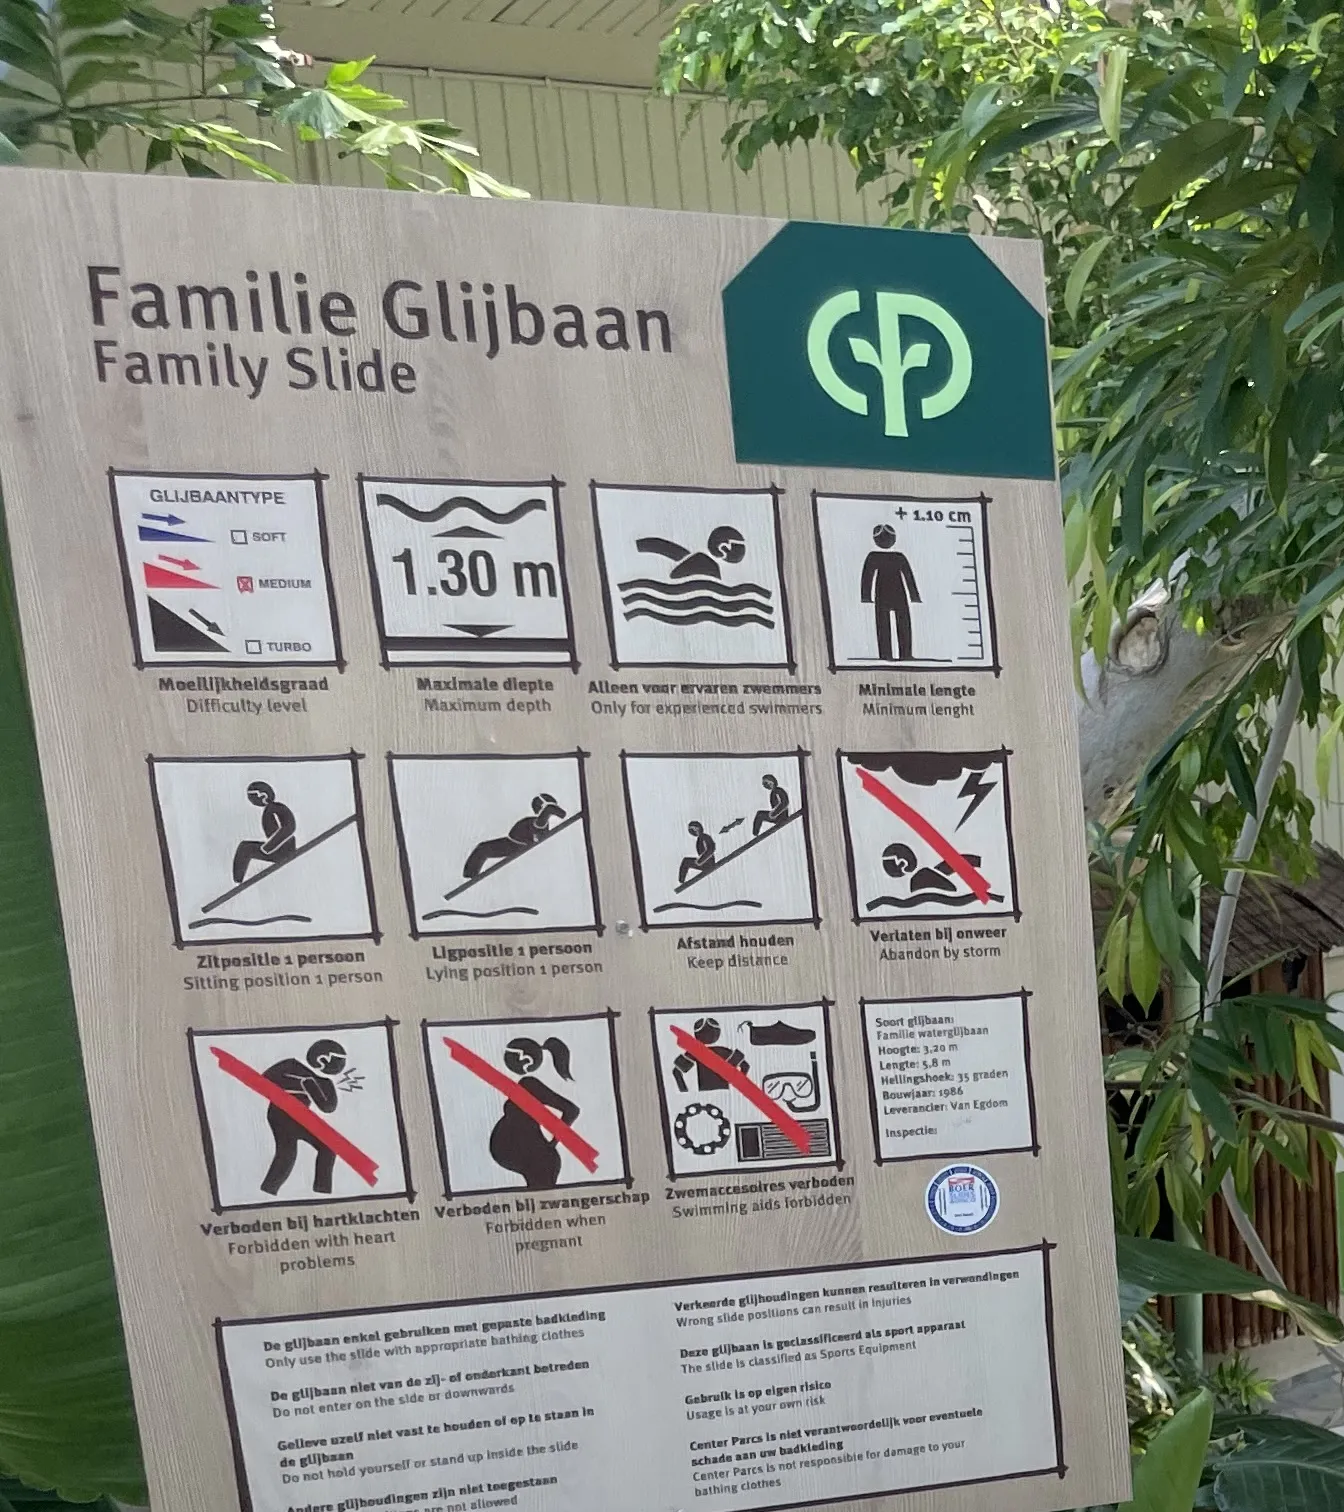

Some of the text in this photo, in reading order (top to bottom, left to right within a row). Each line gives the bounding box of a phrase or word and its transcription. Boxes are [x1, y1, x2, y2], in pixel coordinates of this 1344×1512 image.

[87, 265, 672, 359] Familie Glijbaan
[93, 340, 416, 400] Family Slide
[150, 489, 287, 505] GLIJBAANTYPE
[913, 510, 944, 523] 1.10
[948, 510, 972, 523] cm
[252, 531, 286, 543] SOFT
[392, 548, 558, 598] 1.30 m
[258, 577, 312, 590] MEDIUM
[266, 641, 312, 653] TURBO
[159, 676, 329, 695] Moeilijkheidsgraad
[417, 677, 554, 696] Maximale diepte
[588, 681, 822, 696] Alleen voor ervaren zwemmers
[858, 683, 976, 702] Minimale lengte
[186, 697, 308, 715] Difficulty level
[424, 698, 551, 717] Maximum depth
[591, 701, 823, 718] Only for experienced swimmers
[862, 702, 975, 719] Minimum lenght
[677, 934, 794, 950] Afstand houden
[870, 926, 1007, 946] Verlaten bij onweer
[197, 951, 365, 972] Zitpositie 1 persoon
[432, 942, 592, 963] Ligpositie 1 persoon
[687, 952, 788, 972] Keep distance
[879, 945, 1001, 964] Abandon by storm
[183, 970, 383, 992] Sitting position 1 person
[426, 961, 603, 985] Lying position 1 person
[876, 1018, 904, 1028] Soort
[877, 1026, 989, 1041] Familie waterglijbaan
[878, 1045, 921, 1057] Hoogte:
[949, 1043, 958, 1052] m
[879, 1060, 920, 1072] Lengte:
[941, 1058, 951, 1068] m
[881, 1069, 1009, 1086] Hellingshoek: 35 graden
[882, 1087, 964, 1102] Bouwjaar: 1986
[884, 1099, 1009, 1116] Leverancier: Van Egdom
[886, 1126, 938, 1139] Inspectie:
[665, 1175, 854, 1201] Zwemaccesoires verboden
[434, 1191, 650, 1219] Verboden bij zwangerschap
[673, 1194, 850, 1218] Swimming aids forbidden
[200, 1207, 420, 1238] Verboden bij hartklachten
[485, 1213, 607, 1236] Forbidden when
[228, 1230, 396, 1256] Forbidden with heart
[515, 1235, 584, 1255] pregnant
[280, 1253, 355, 1275] problems
[676, 1296, 912, 1328] Wrong slide positions can result in injuries
[273, 1383, 514, 1418] Do not enter on the side or downwards
[685, 1381, 832, 1404] Gebruik is op eigen risico
[686, 1394, 826, 1421] Usage is at your own risk
[282, 1441, 578, 1484] Do not hold yourself or stand up inside the slide
[338, 1492, 428, 1512] glijhoudingen
[432, 1488, 455, 1501] zijn
[459, 1484, 483, 1496] niet
[487, 1475, 558, 1494] toegestaan
